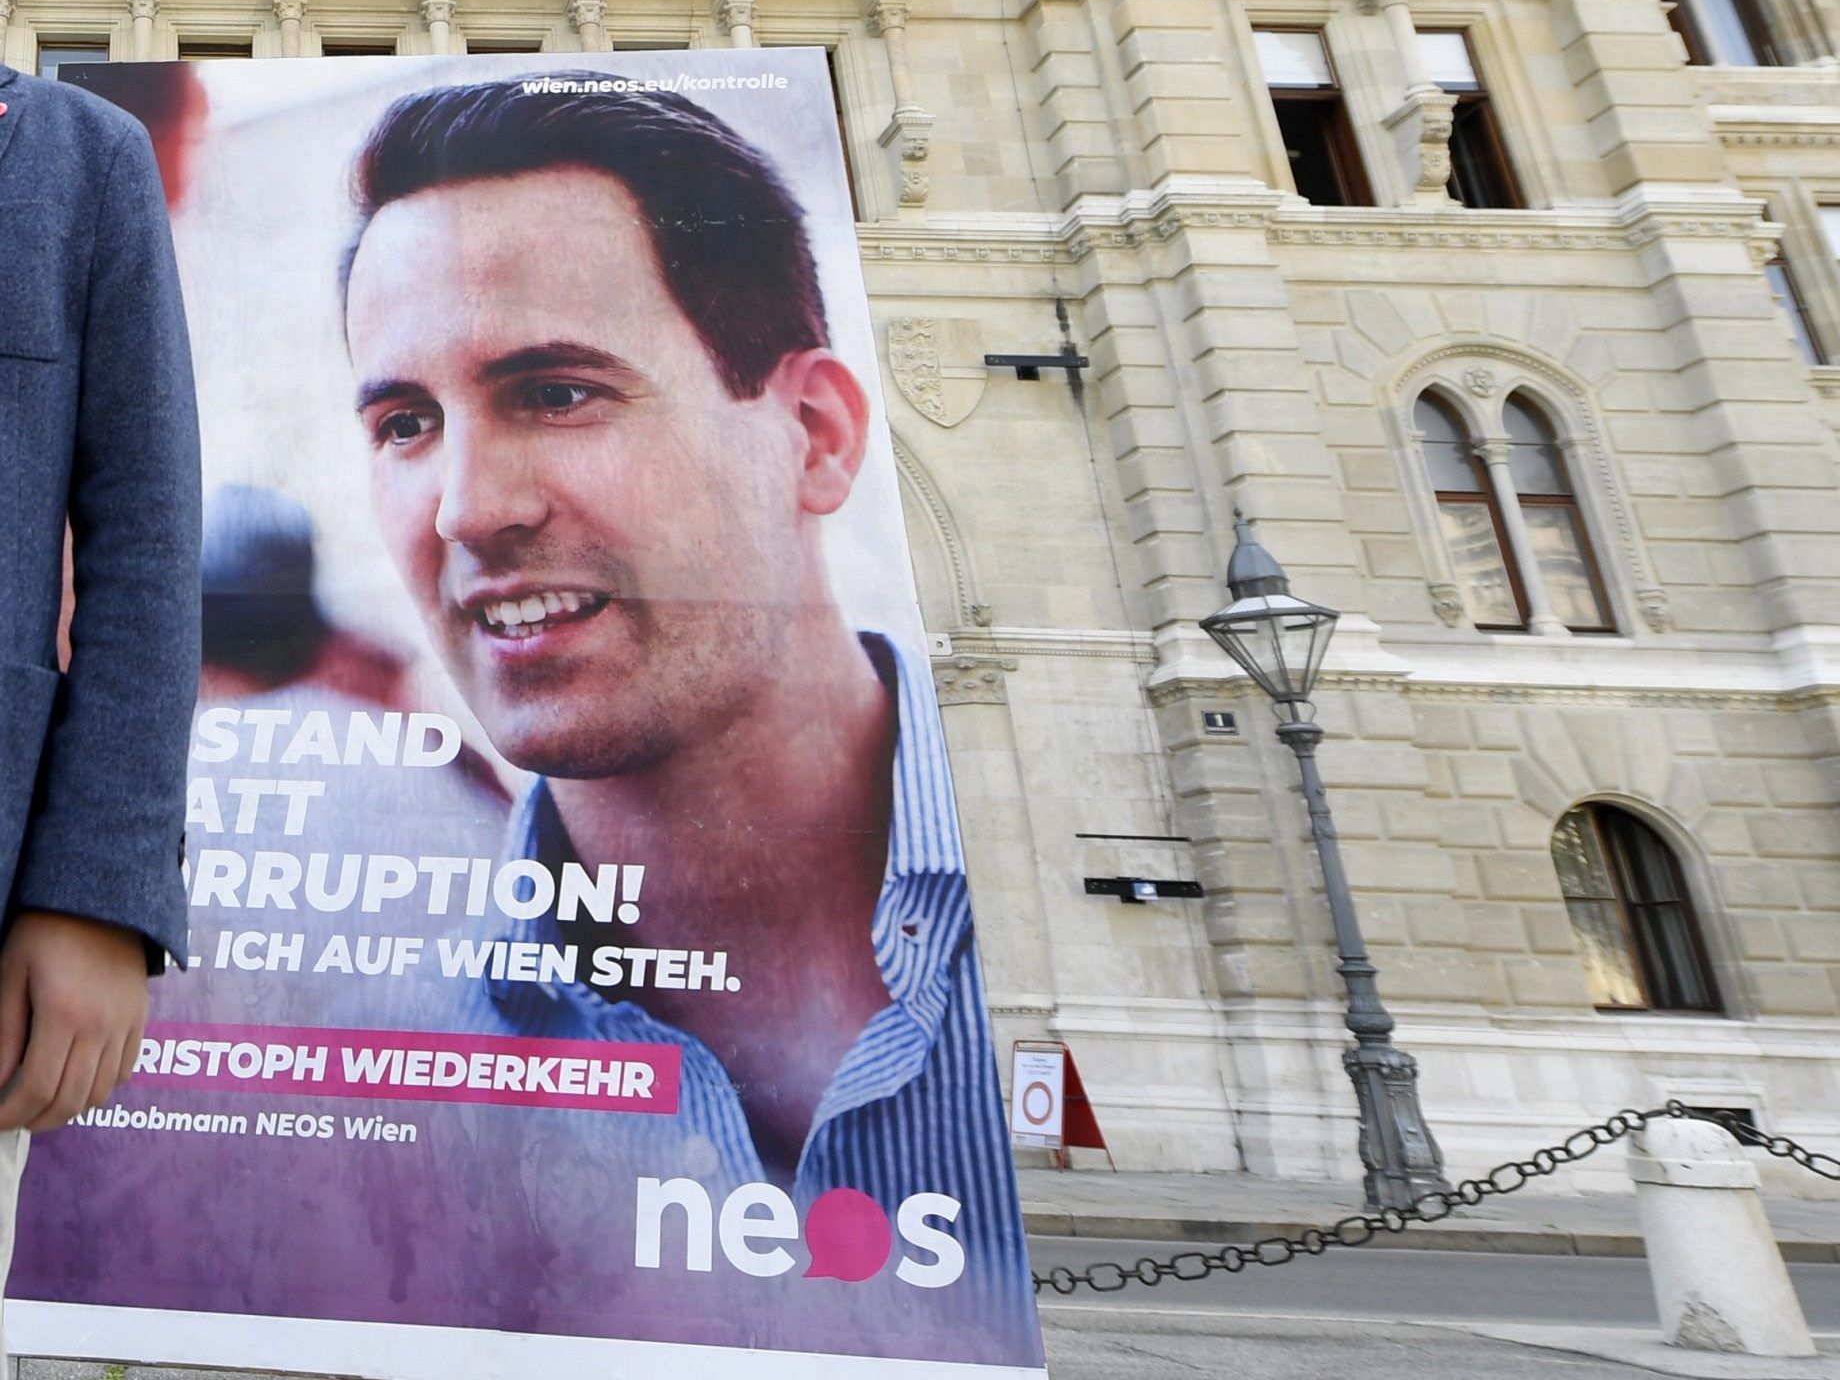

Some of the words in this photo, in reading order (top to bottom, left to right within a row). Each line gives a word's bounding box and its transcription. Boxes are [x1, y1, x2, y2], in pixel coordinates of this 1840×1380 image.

[522, 73, 788, 94] wien.neos.eu/kontrolle
[181, 849, 645, 925] RRUPTION!
[214, 930, 304, 972] ICH
[313, 935, 424, 976] AUF
[437, 939, 579, 984] WIEN
[589, 946, 741, 993] STEH.
[341, 1047, 655, 1099] WIEDERKEHR
[255, 1112, 335, 1140] NEOS
[344, 1115, 417, 1143] Wien
[635, 1177, 966, 1289] neos
